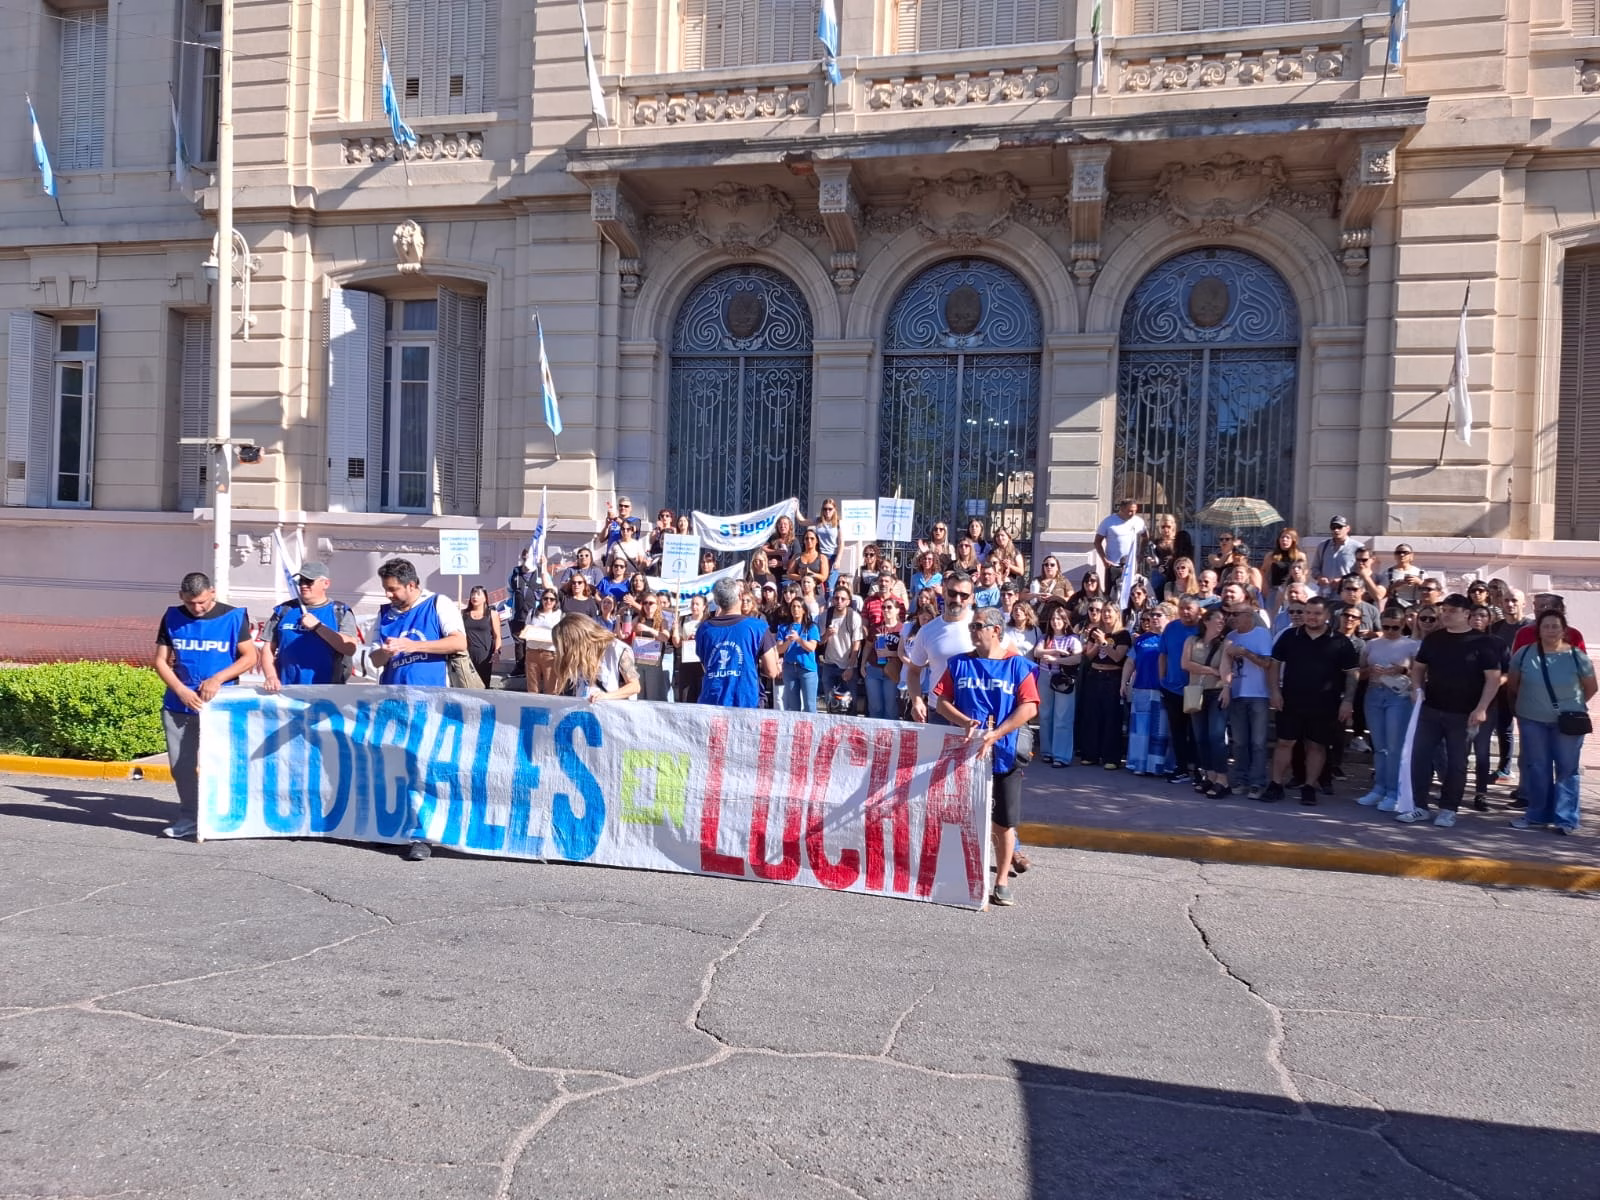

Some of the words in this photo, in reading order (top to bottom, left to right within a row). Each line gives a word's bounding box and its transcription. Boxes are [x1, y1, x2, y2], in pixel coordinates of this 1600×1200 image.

[173, 638, 230, 653] SIJUPU
[206, 697, 607, 862] JUDICIALES
[619, 749, 690, 829] EN
[699, 714, 985, 901] LUCHA
